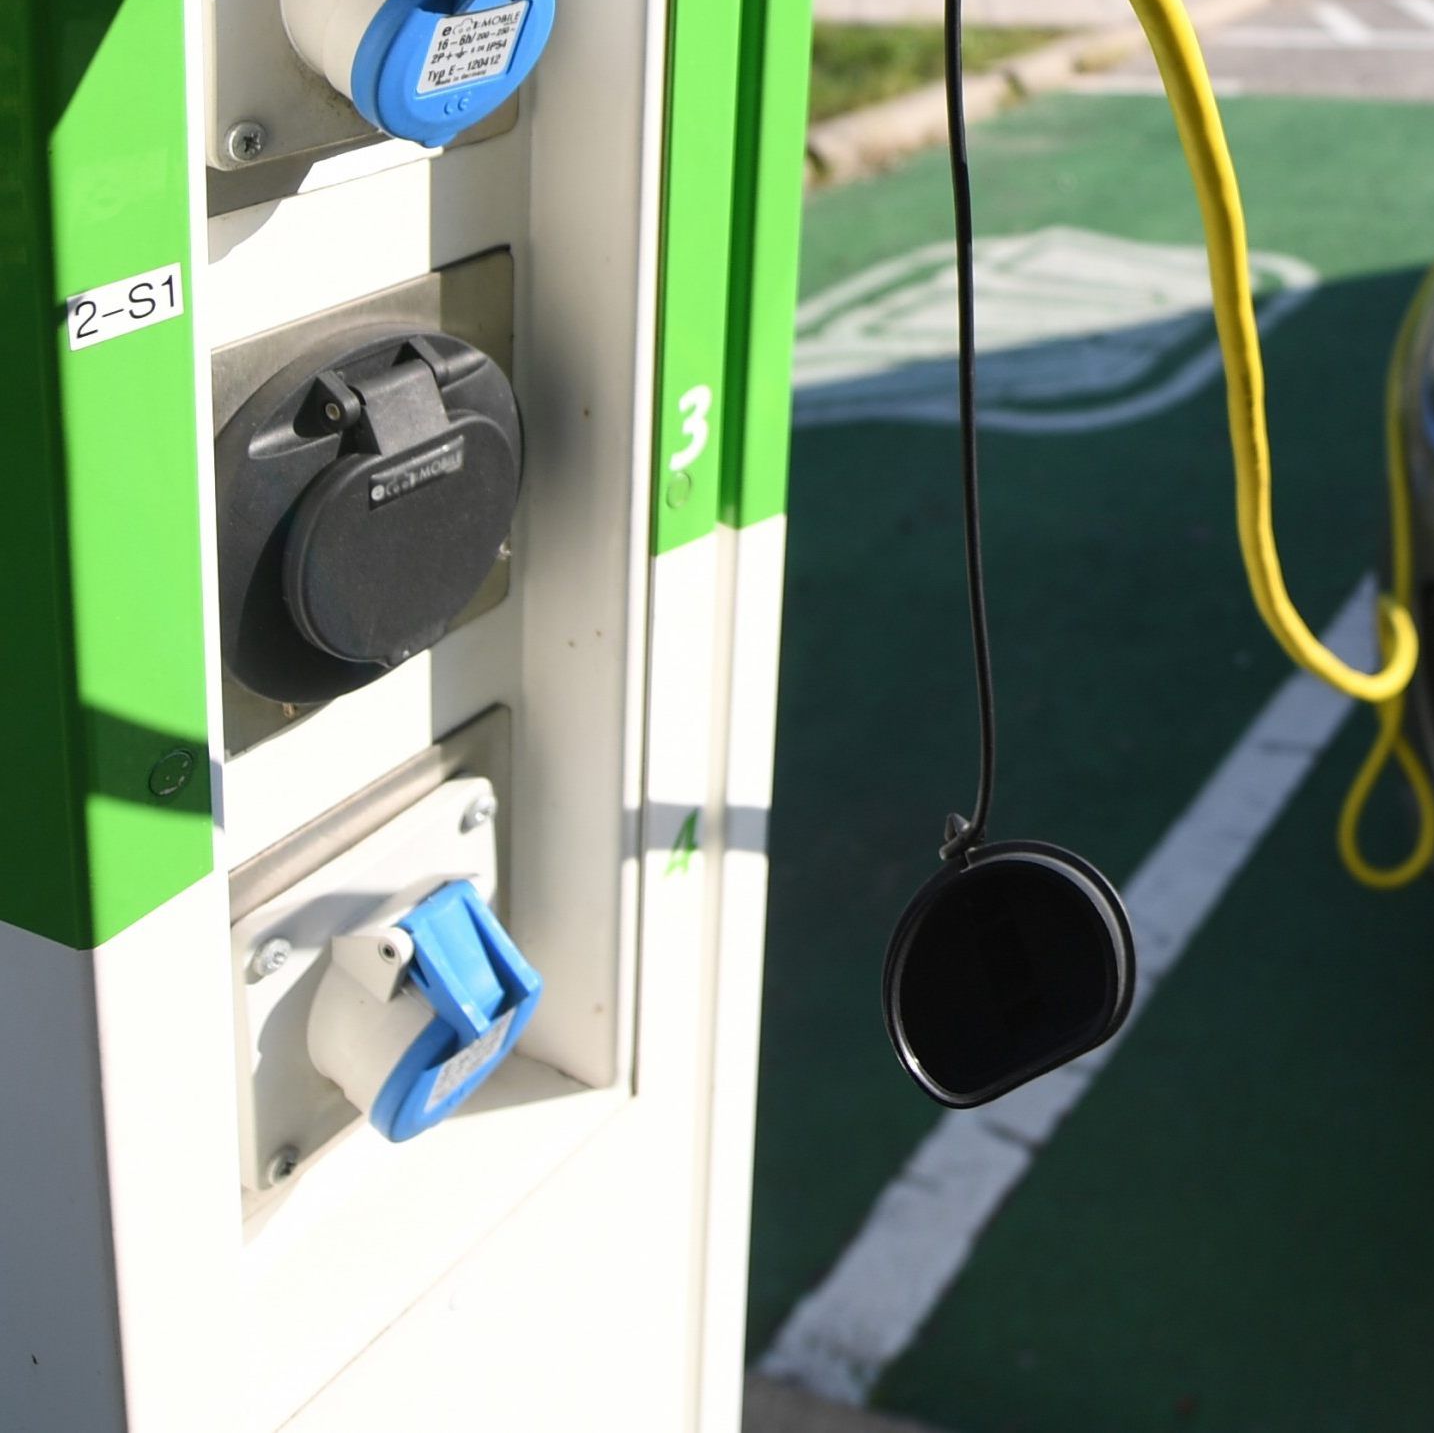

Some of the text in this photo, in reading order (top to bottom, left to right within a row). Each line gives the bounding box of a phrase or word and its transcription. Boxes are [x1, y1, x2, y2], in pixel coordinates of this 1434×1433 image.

[486, 39, 507, 52] IP54
[427, 69, 446, 83] Typ
[72, 275, 179, 339] 2-S1
[670, 385, 712, 469] 3
